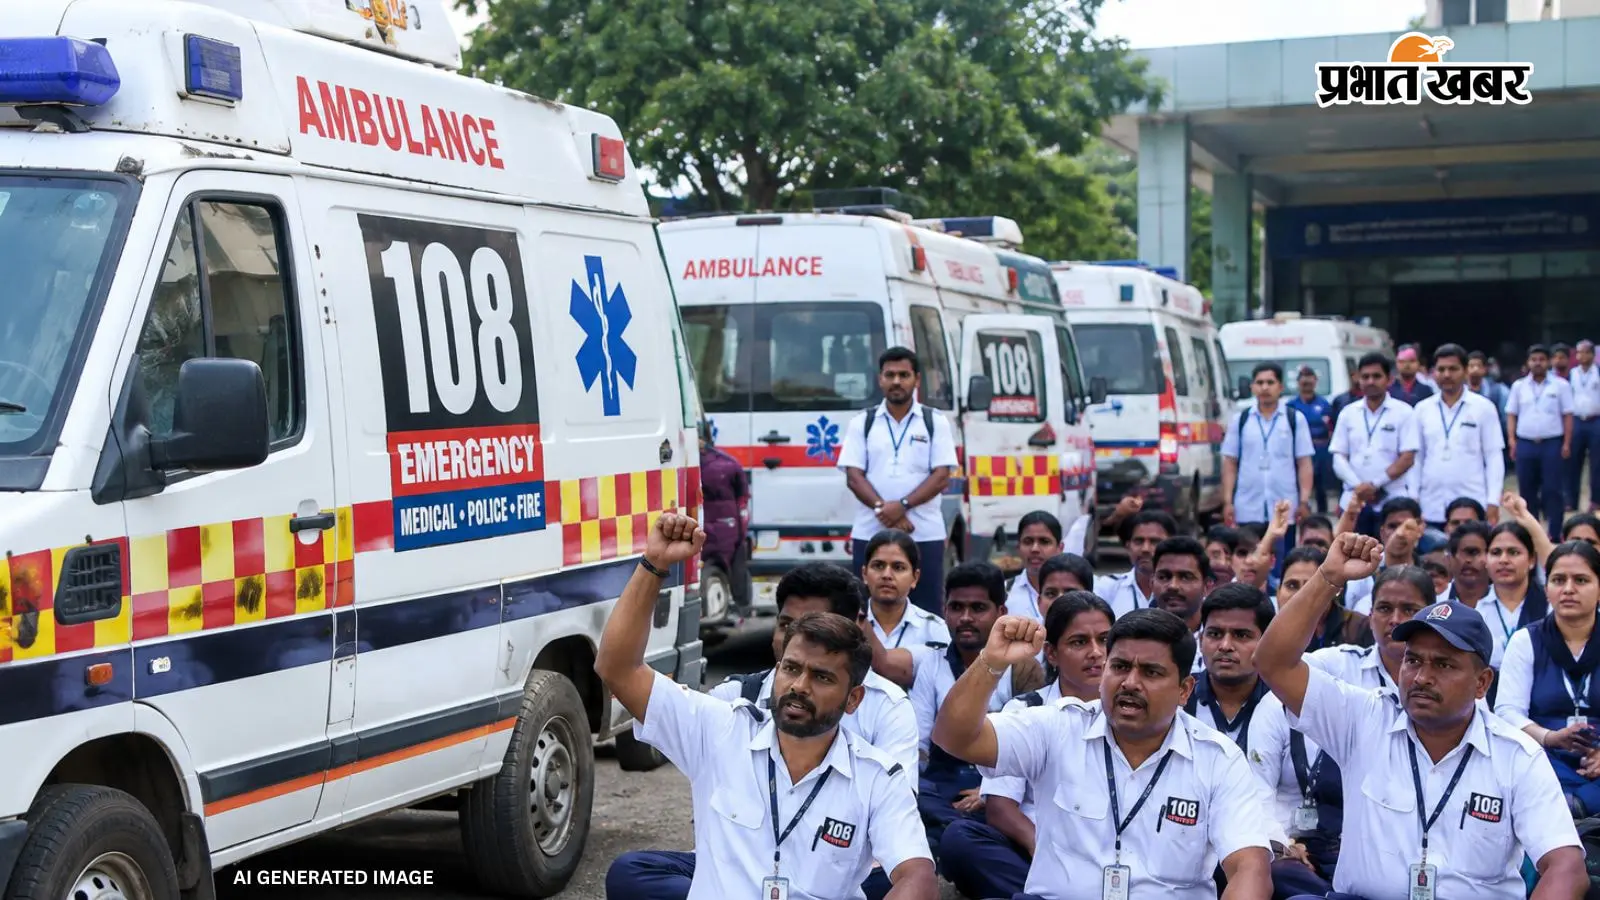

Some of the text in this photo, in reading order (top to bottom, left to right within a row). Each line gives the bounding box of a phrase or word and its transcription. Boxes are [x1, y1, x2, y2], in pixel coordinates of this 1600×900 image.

[296, 75, 505, 170] AMBULANCE
[683, 256, 823, 280] AMBULANCE
[380, 240, 523, 415] 108
[984, 342, 1033, 395] 108
[397, 435, 534, 485] EMERGENCY
[400, 492, 541, 537] MEDICAL POLICE FIRE
